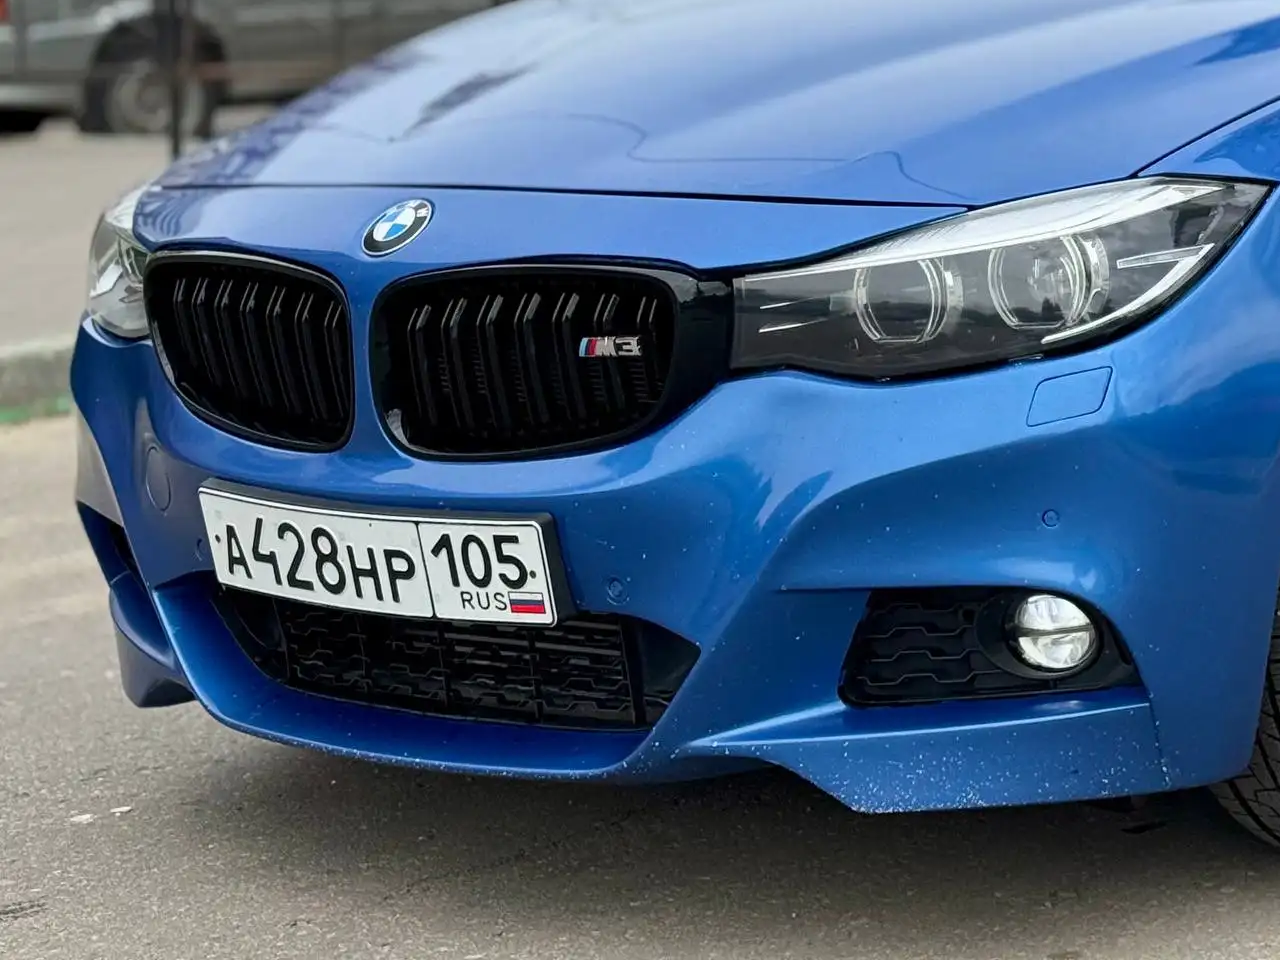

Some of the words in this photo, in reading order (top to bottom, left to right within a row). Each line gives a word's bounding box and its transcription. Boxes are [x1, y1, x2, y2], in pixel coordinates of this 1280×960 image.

[596, 336, 641, 357] M3
[225, 517, 416, 604] А428НР
[430, 533, 529, 590] 105
[460, 591, 508, 611] RUS
